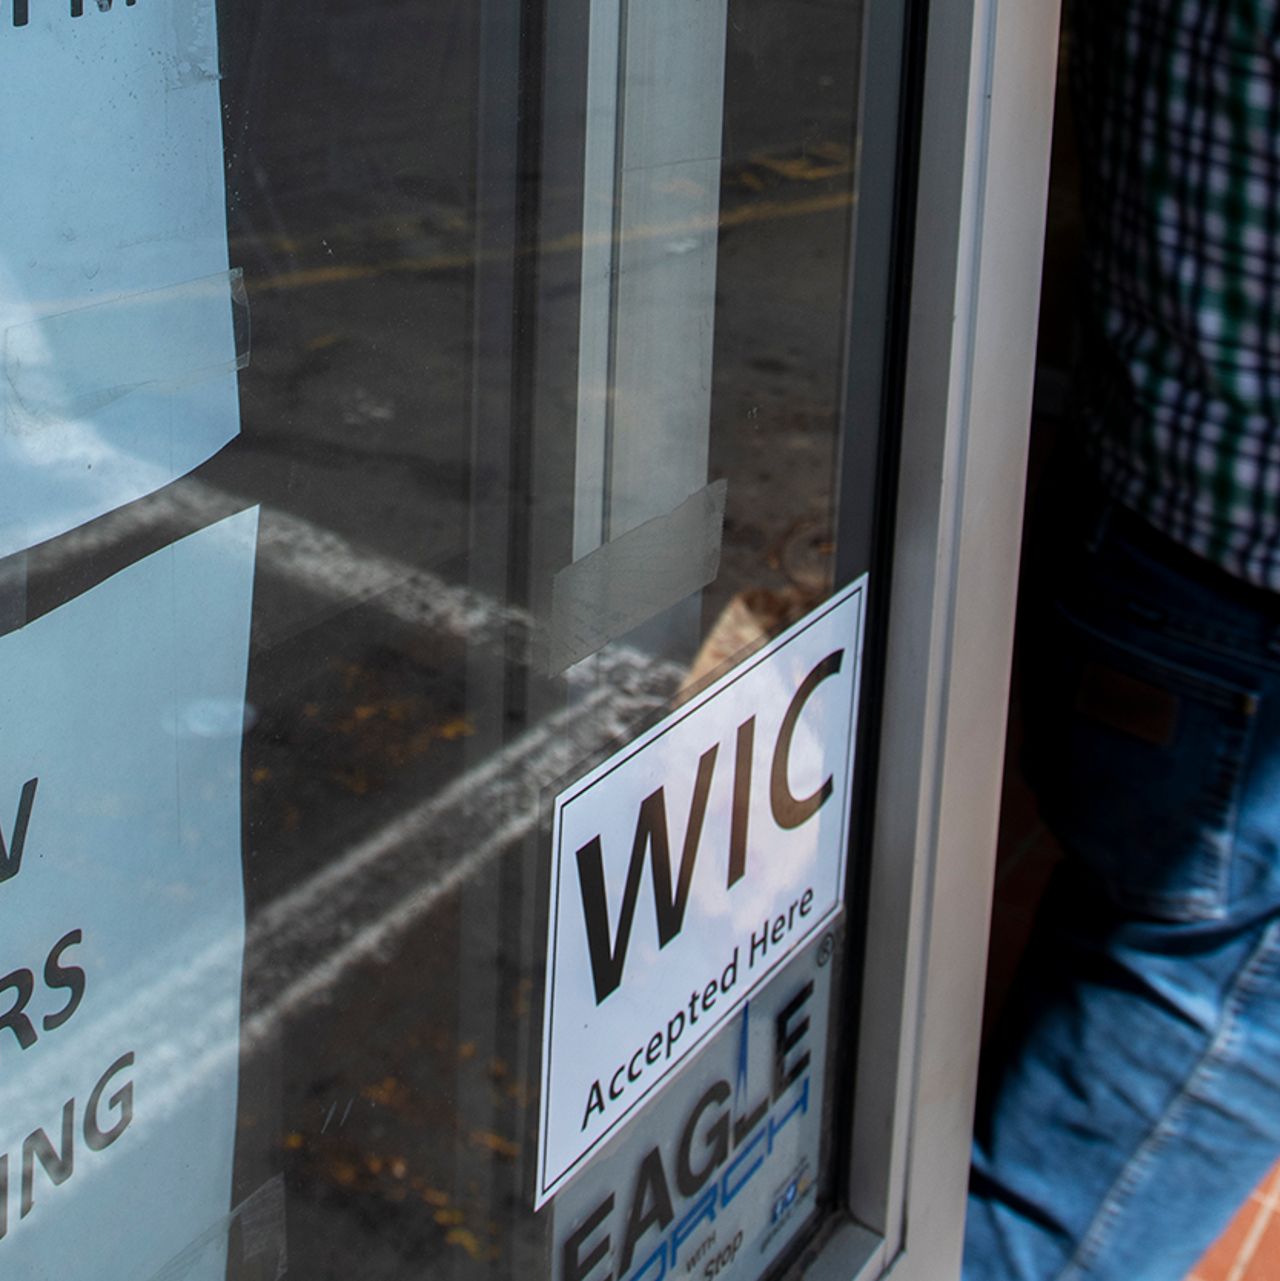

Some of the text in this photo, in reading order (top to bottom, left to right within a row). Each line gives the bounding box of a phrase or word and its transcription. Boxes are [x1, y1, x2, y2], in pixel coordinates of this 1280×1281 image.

[575, 648, 846, 1007] WIC
[563, 978, 814, 1281] EAGLE
[580, 886, 815, 1132] Accepted Here
